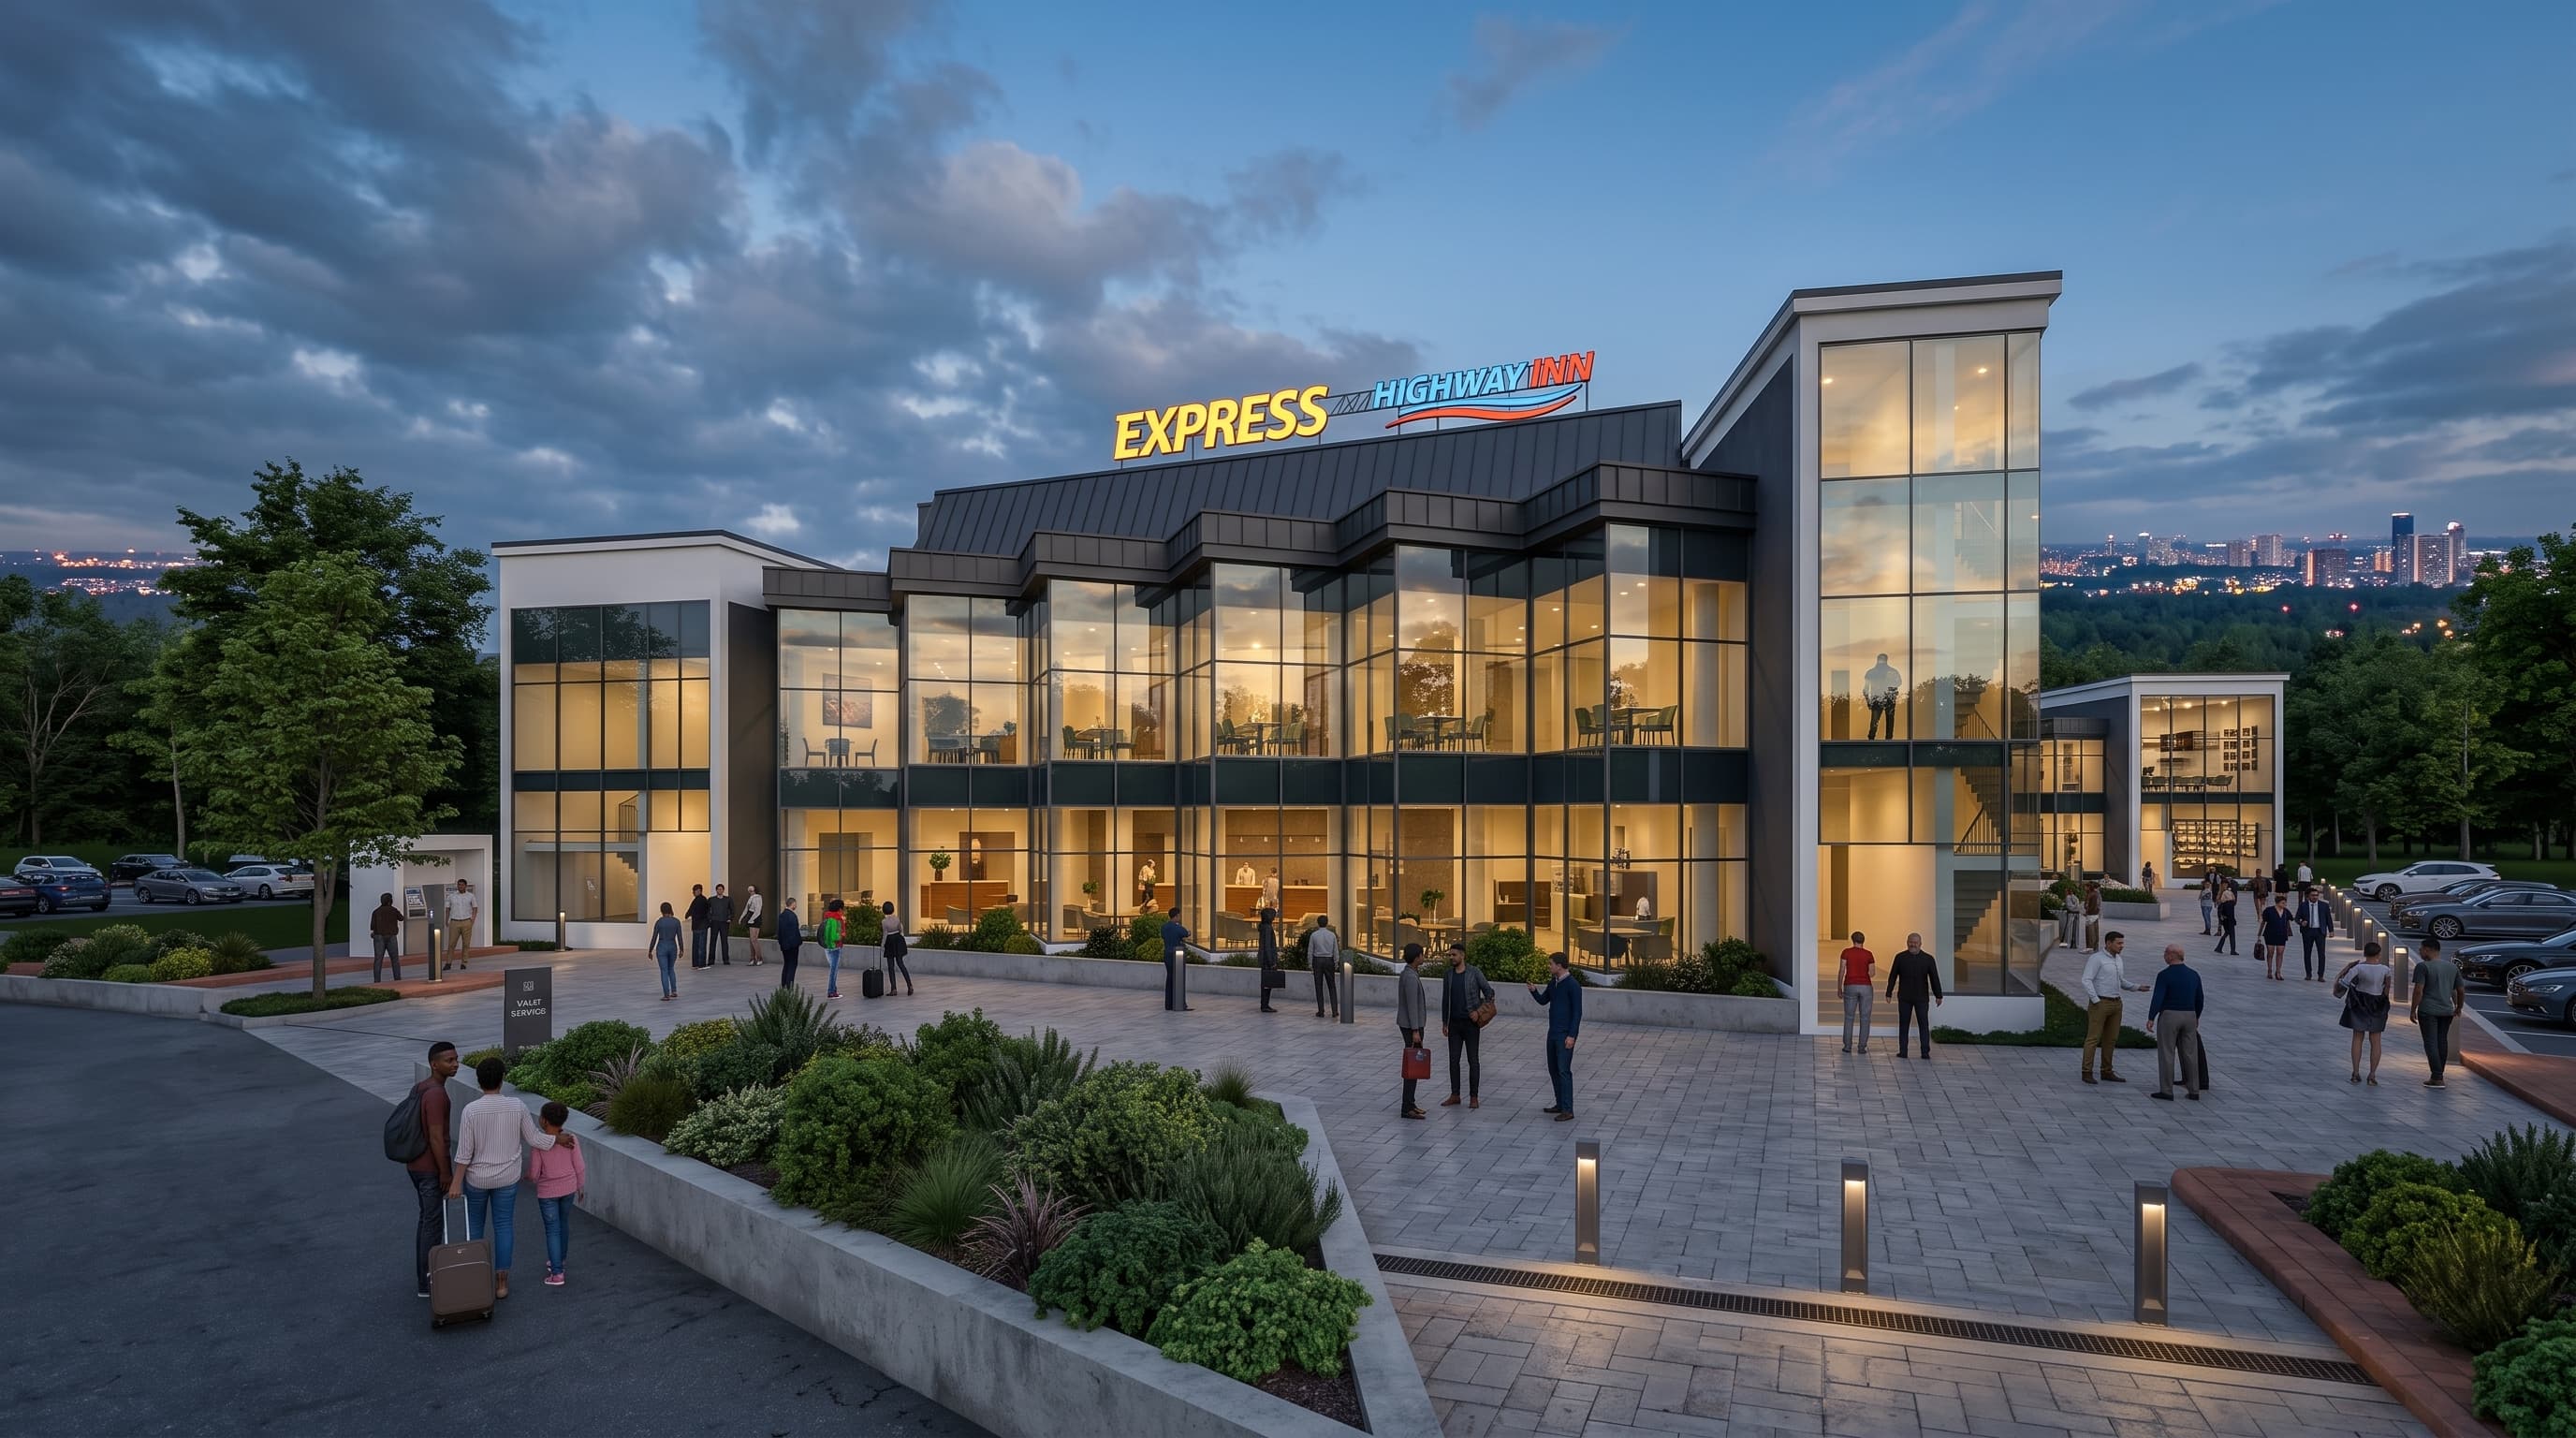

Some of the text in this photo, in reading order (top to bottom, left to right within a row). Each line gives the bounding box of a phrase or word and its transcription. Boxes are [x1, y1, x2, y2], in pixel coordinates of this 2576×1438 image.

[1114, 350, 1595, 460] EXPRESS HIGHWAY INN
[517, 998, 542, 1007] VALET
